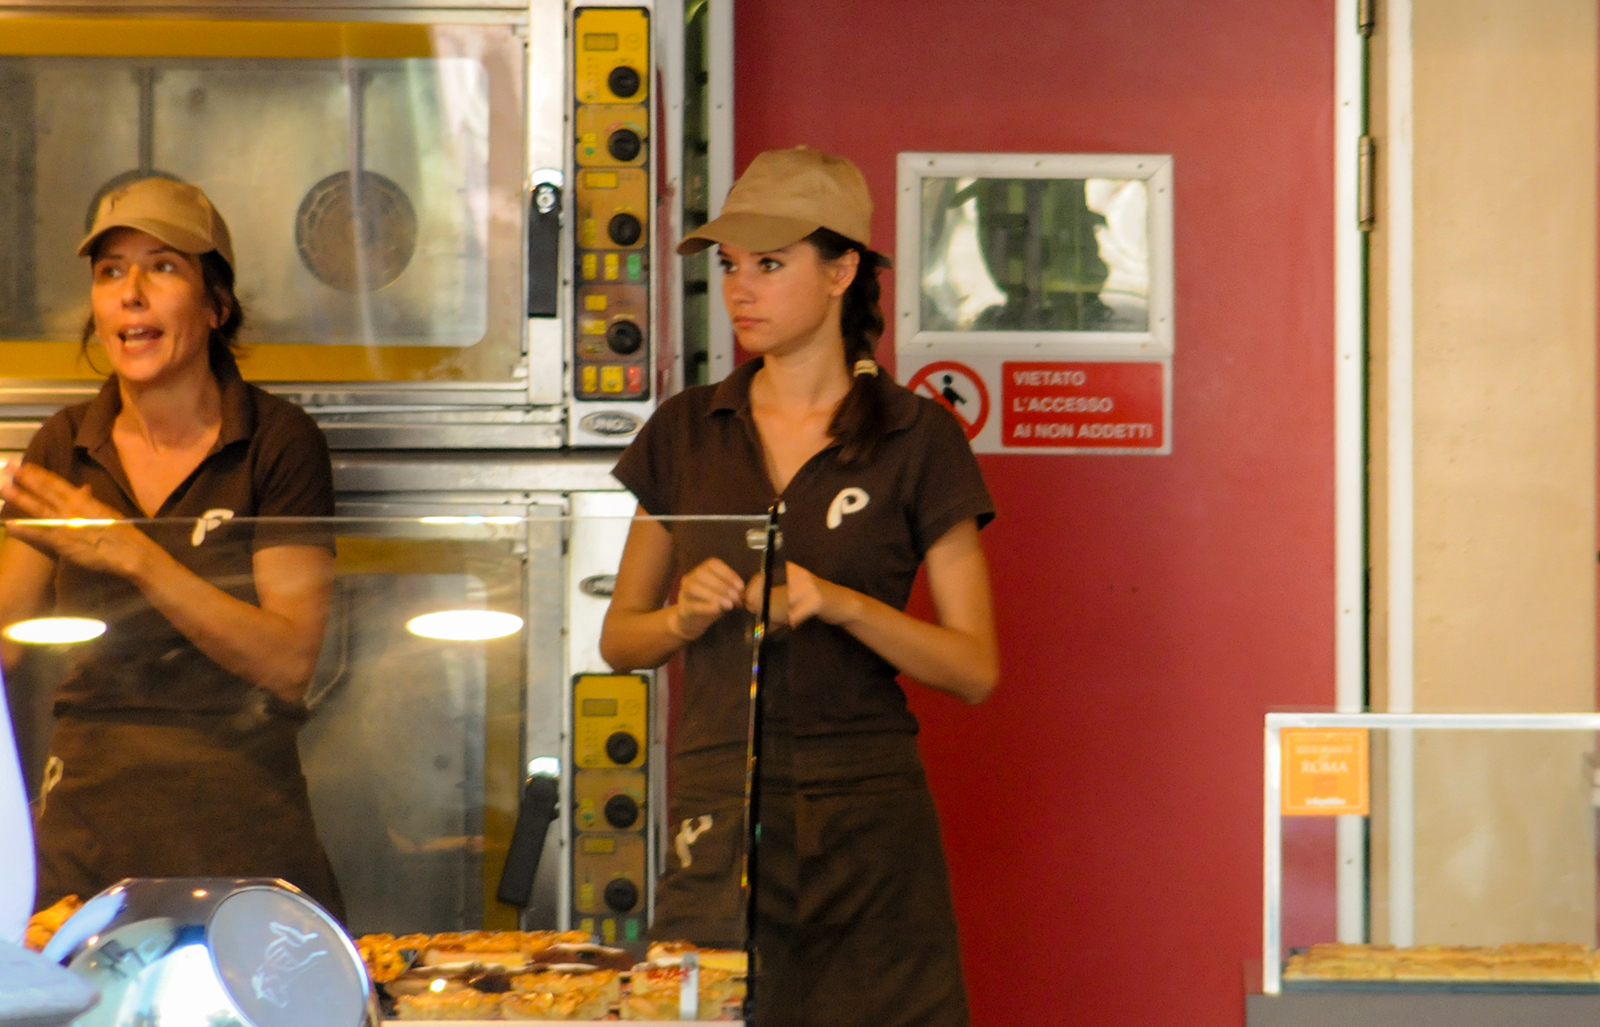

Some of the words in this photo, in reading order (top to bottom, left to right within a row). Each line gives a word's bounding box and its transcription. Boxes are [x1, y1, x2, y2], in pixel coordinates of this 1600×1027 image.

[1013, 371, 1086, 386] VIETATO
[1013, 397, 1114, 412] L'ACCESSO
[1013, 423, 1032, 438] AI
[1035, 423, 1075, 438] NON
[1077, 423, 1153, 439] ADDETTI
[1301, 760, 1349, 774] ROMA
